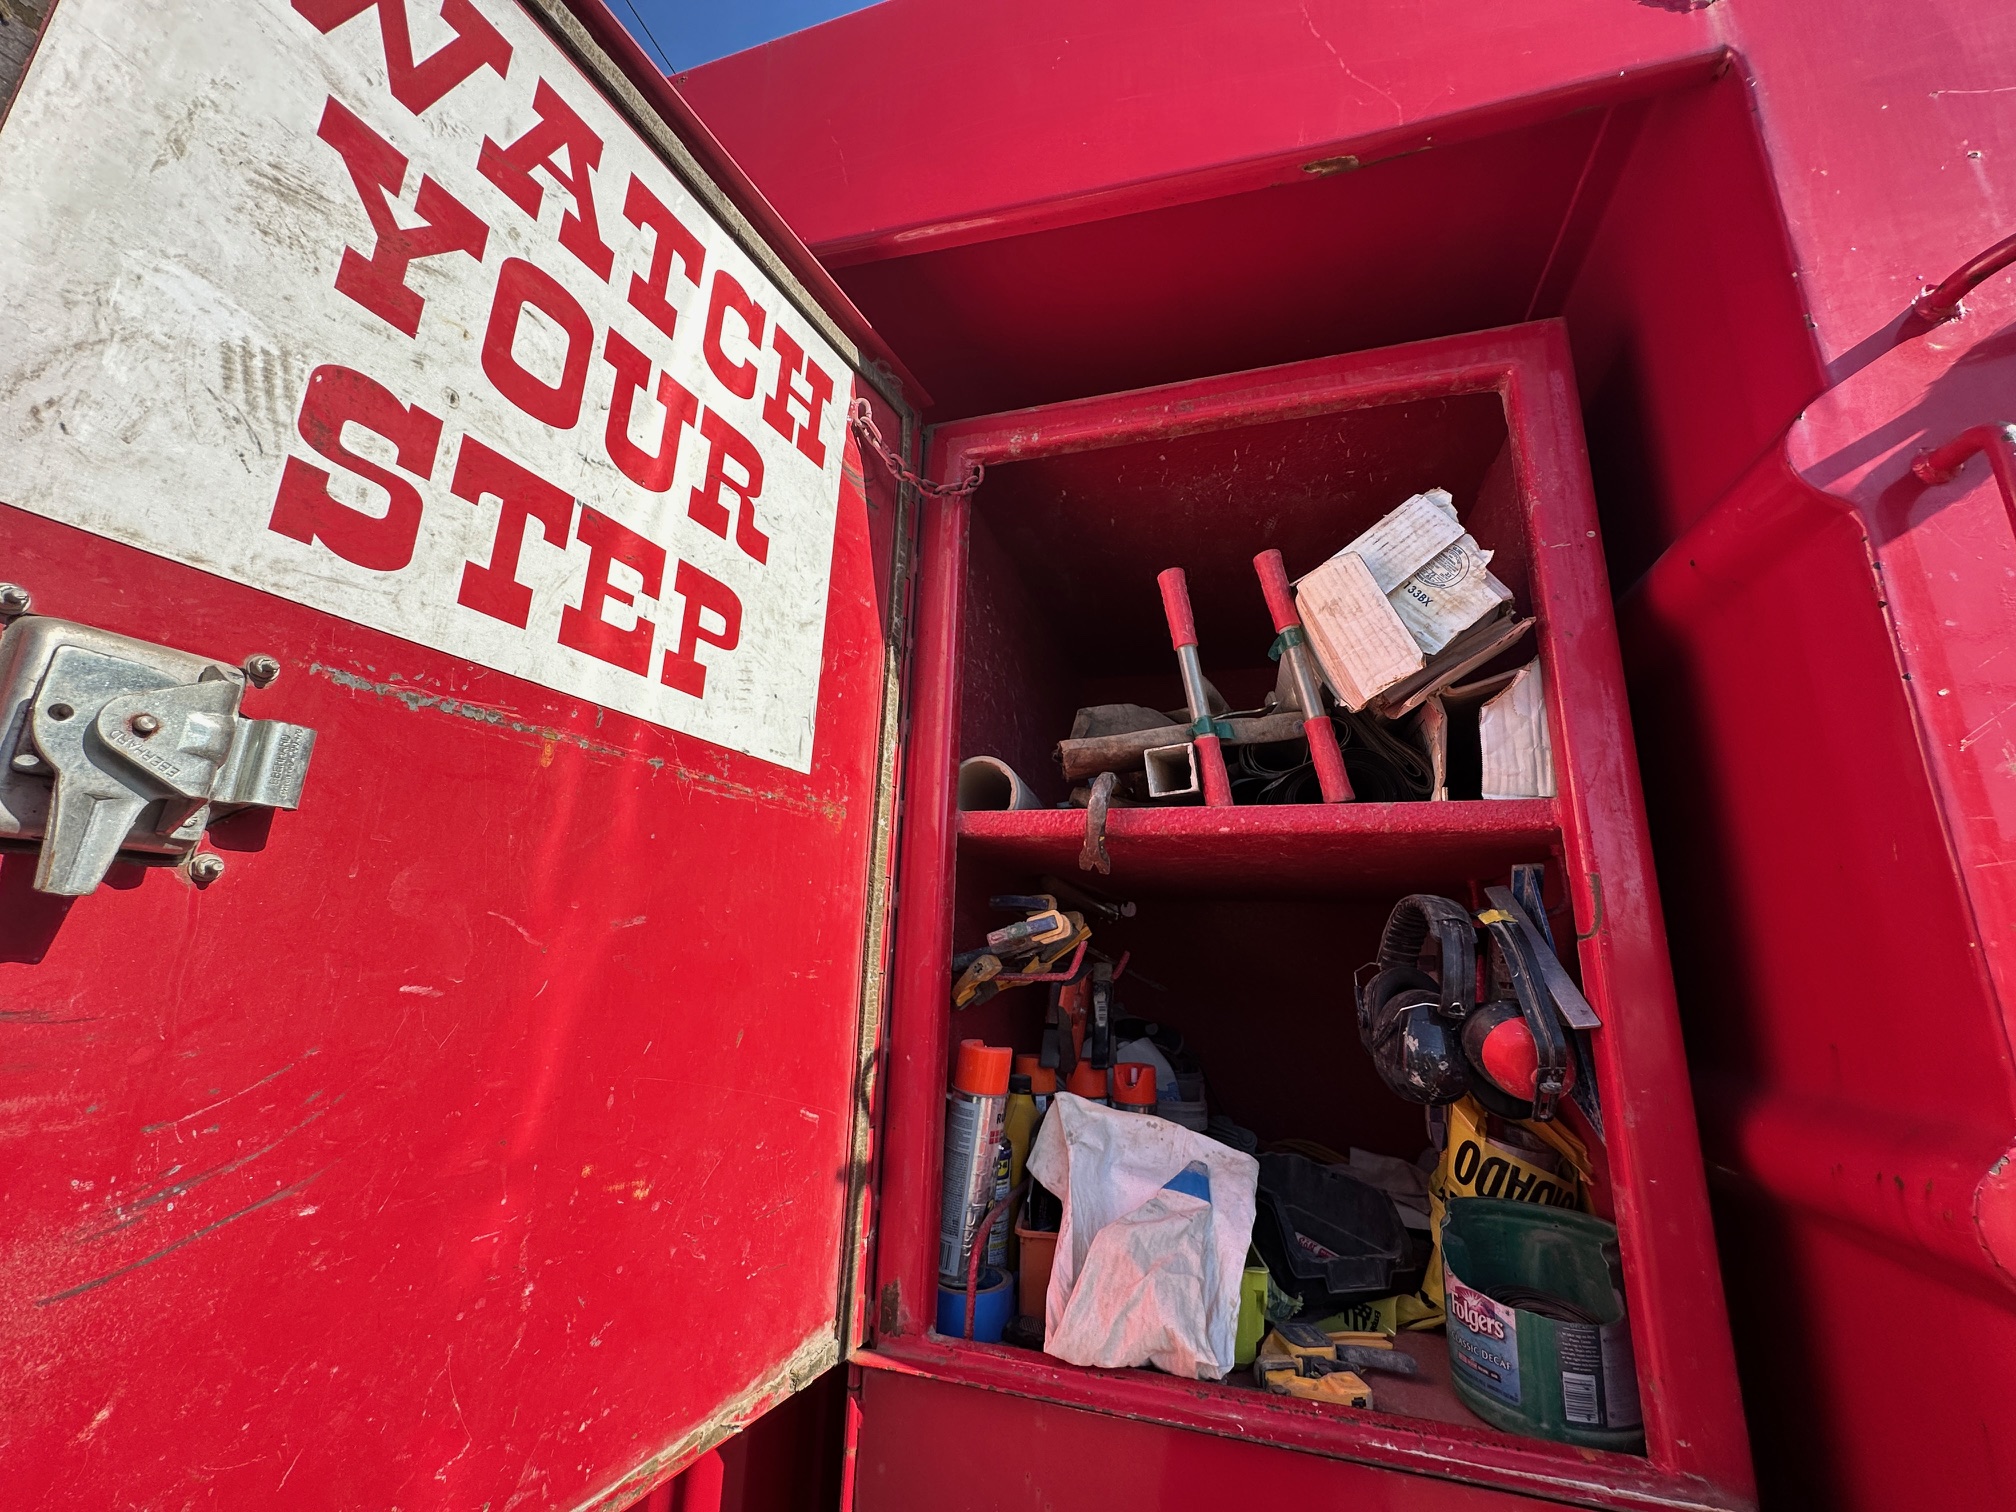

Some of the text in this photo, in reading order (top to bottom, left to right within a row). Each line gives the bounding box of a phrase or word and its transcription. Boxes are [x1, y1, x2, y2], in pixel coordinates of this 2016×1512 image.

[318, 97, 769, 564] YOUR
[269, 365, 742, 698] STEP
[1450, 1289, 1505, 1340] Folgers
[1451, 1330, 1480, 1356] CLASSIC
[1481, 1349, 1512, 1371] DECAF
